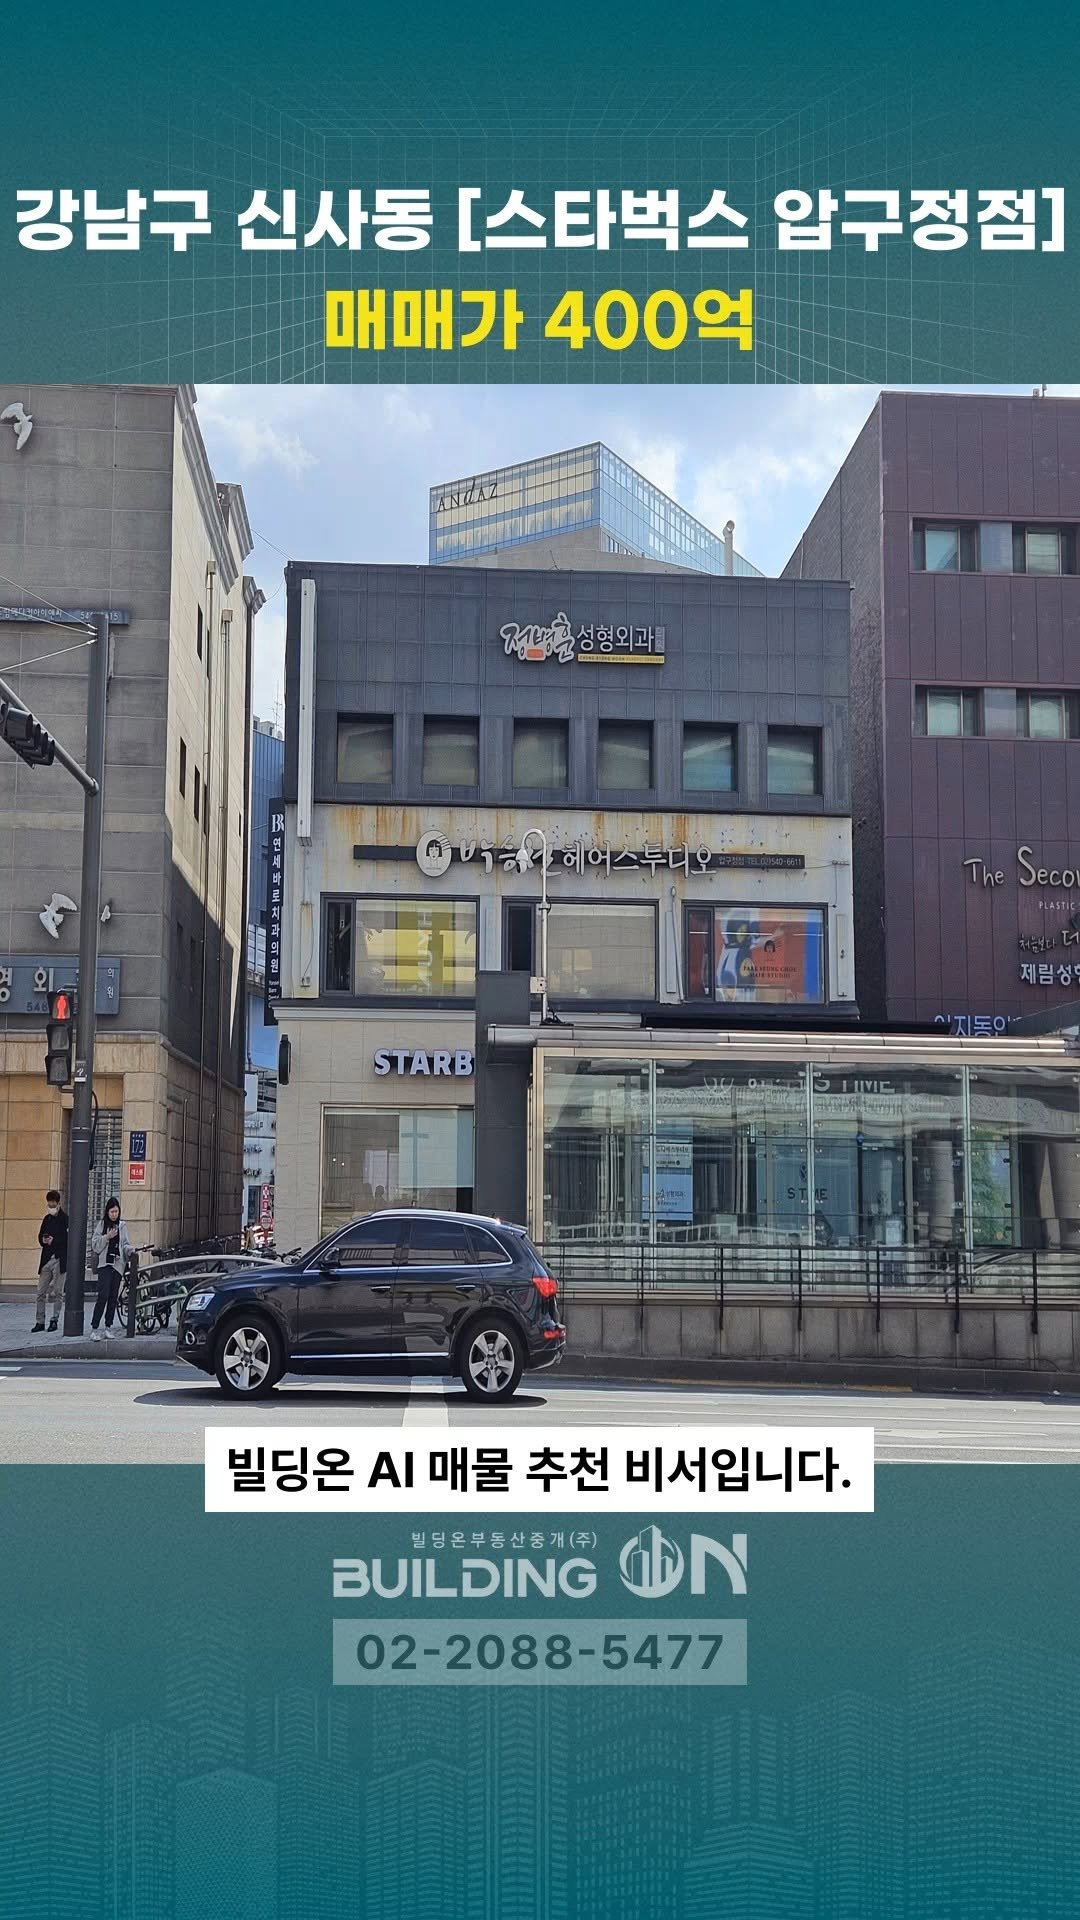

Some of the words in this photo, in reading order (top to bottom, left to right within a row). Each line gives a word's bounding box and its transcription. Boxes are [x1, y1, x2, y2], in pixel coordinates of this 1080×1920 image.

[577, 623, 654, 653] 성형외과
[561, 840, 717, 878] 헤어스투디오
[962, 858, 1004, 888] The
[271, 837, 282, 974] 연세바로치과의원
[1039, 901, 1075, 911] PLASTIC
[131, 1139, 145, 1153] 172
